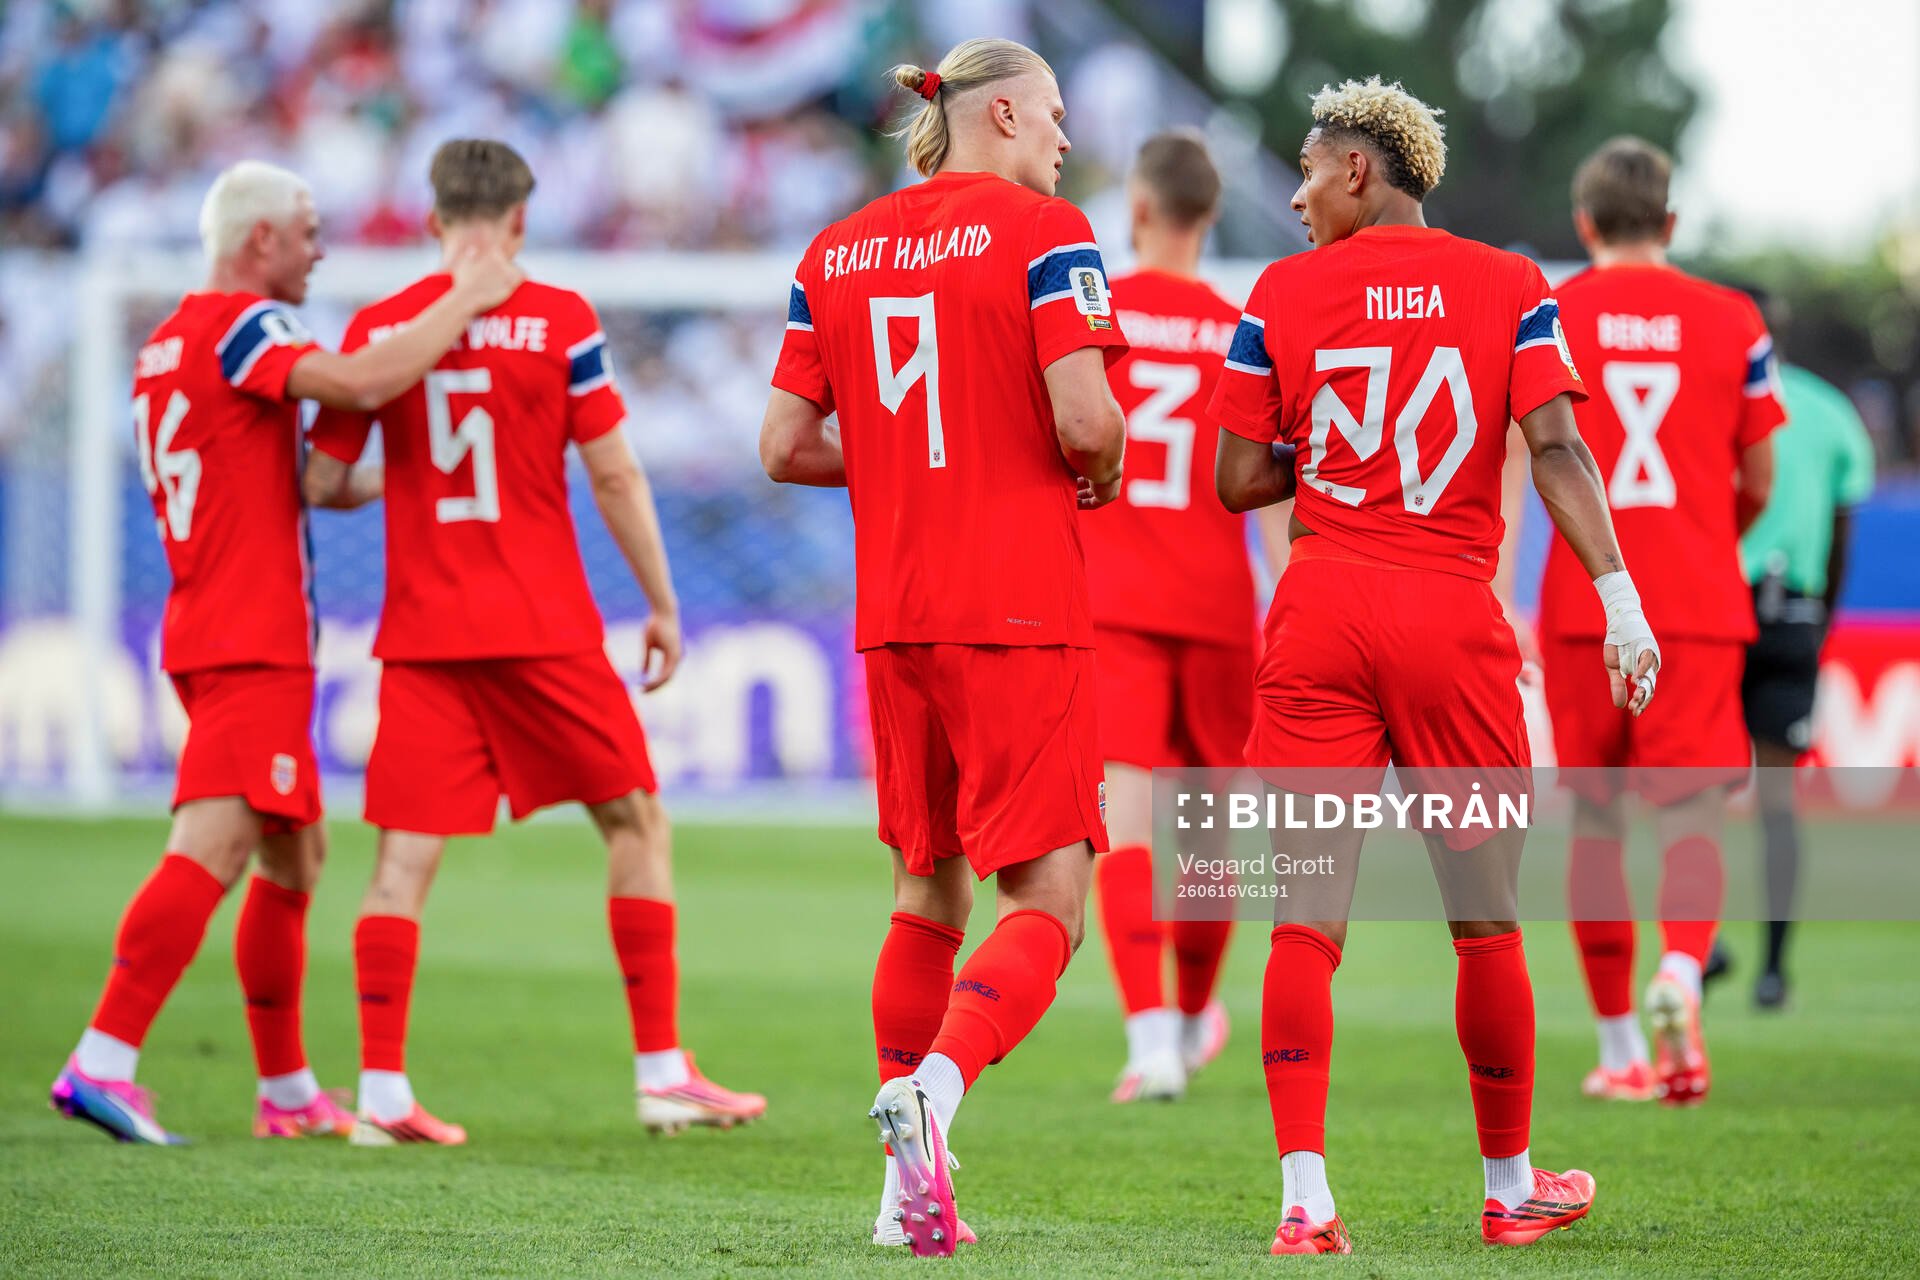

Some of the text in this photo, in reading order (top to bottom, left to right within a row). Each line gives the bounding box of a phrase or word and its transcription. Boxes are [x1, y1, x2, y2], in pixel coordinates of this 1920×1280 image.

[824, 224, 992, 282] BRAUT HAALAND
[1365, 284, 1446, 321] NUSA
[424, 367, 501, 523] 5
[868, 291, 947, 469] 9
[1126, 359, 1201, 510] 3
[1301, 346, 1479, 516] 20
[1602, 361, 1681, 510] 8
